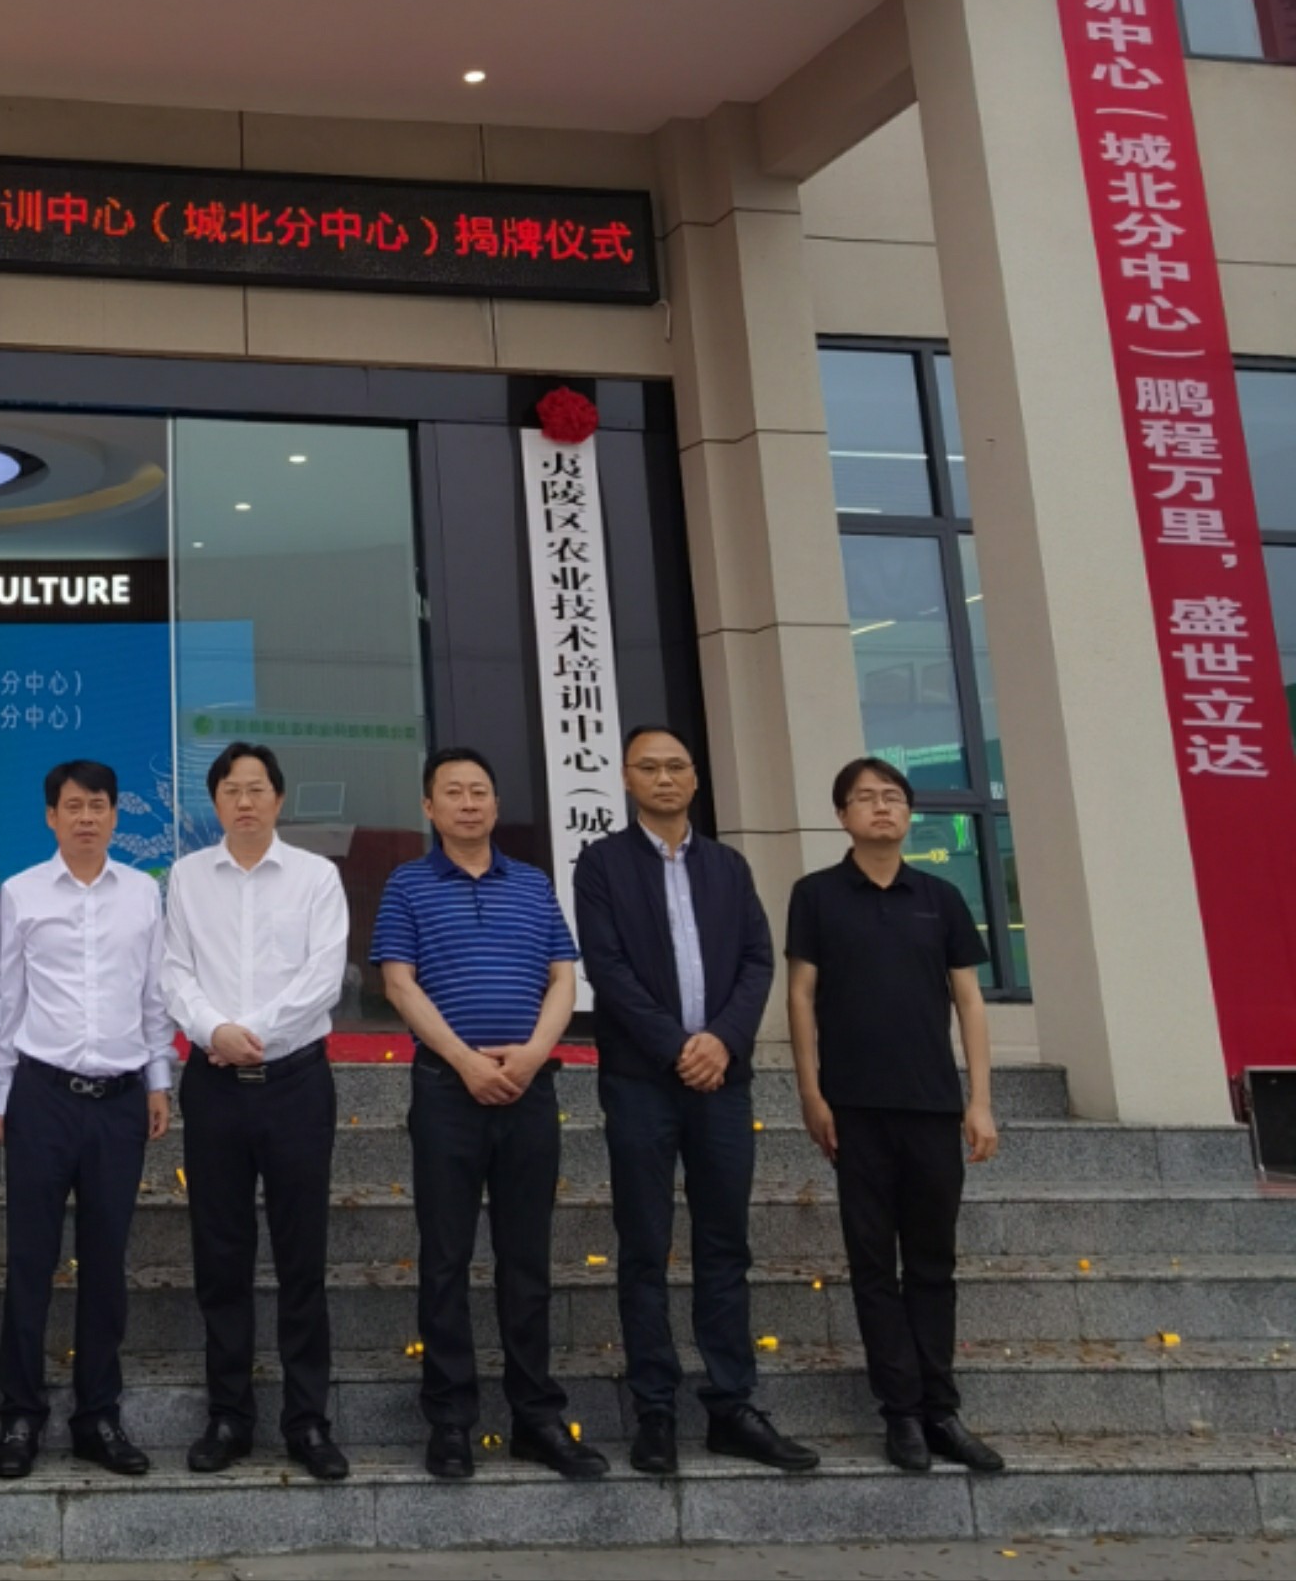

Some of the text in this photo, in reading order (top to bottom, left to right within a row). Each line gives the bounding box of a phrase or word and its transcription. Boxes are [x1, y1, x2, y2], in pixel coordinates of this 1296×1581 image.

[540, 451, 615, 864] 夷陵区农业技术培训中心（城
